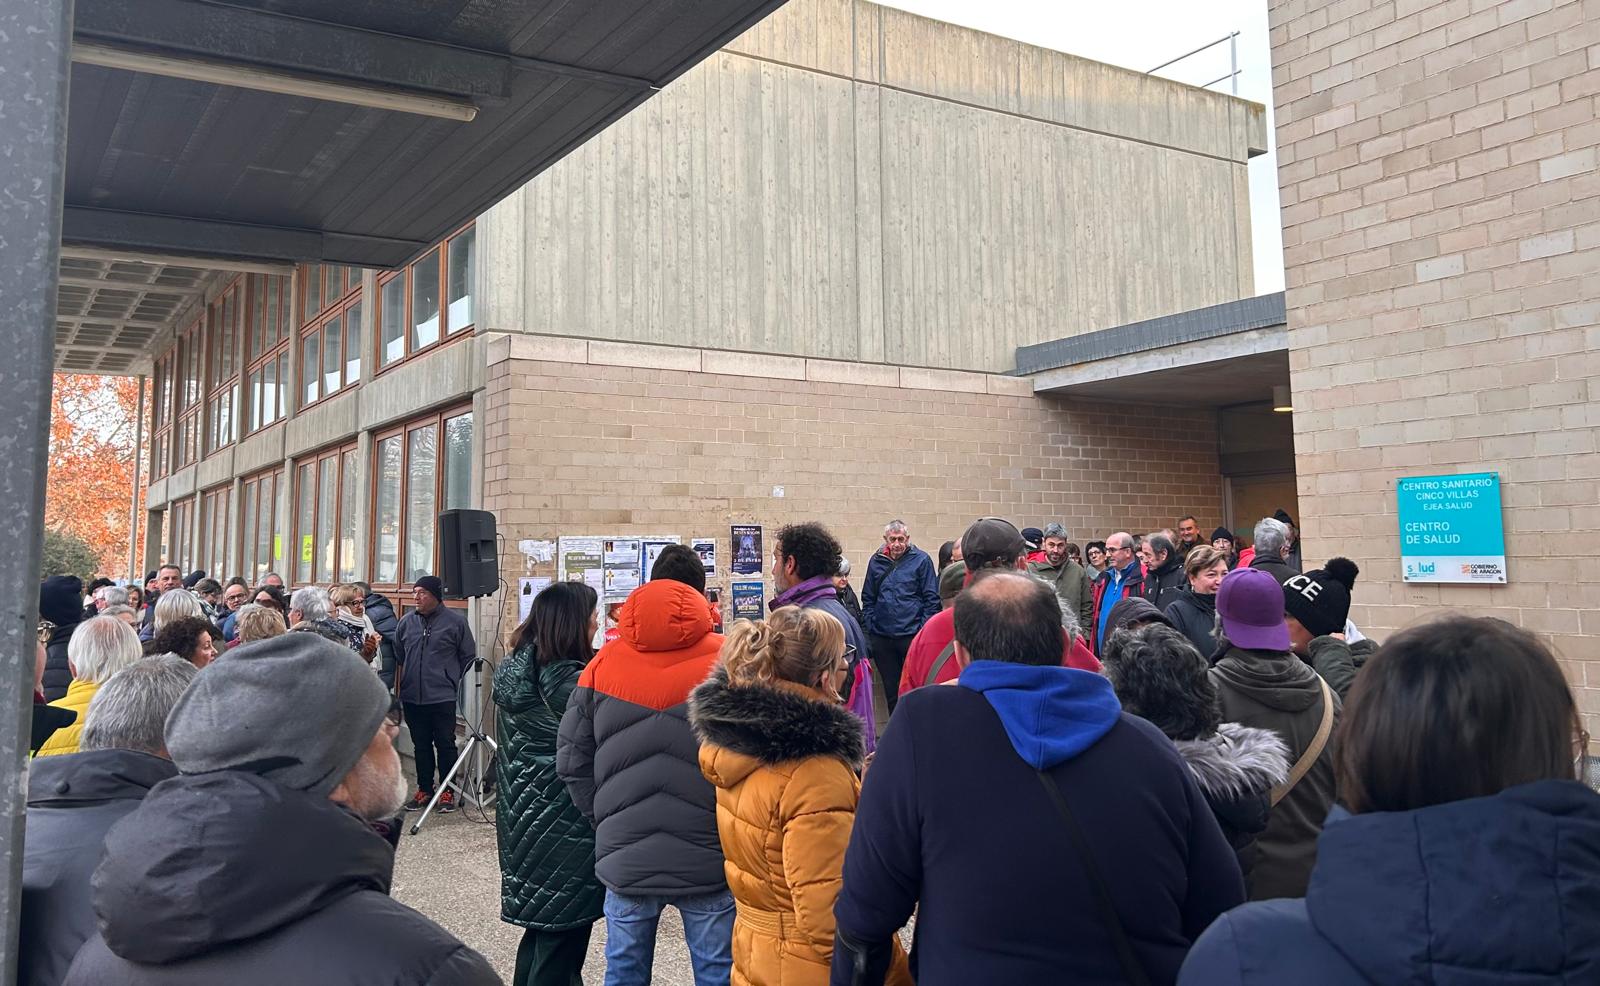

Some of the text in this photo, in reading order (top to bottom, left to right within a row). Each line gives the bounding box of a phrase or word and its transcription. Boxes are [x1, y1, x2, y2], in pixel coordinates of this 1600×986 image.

[1402, 478, 1493, 491] CENTRO SANITARIO
[1415, 489, 1480, 501] CINCO VILLAS
[1423, 501, 1473, 511] EJEA SALUD
[1405, 521, 1450, 532] CENTRO
[1406, 533, 1461, 545] DE SALUD
